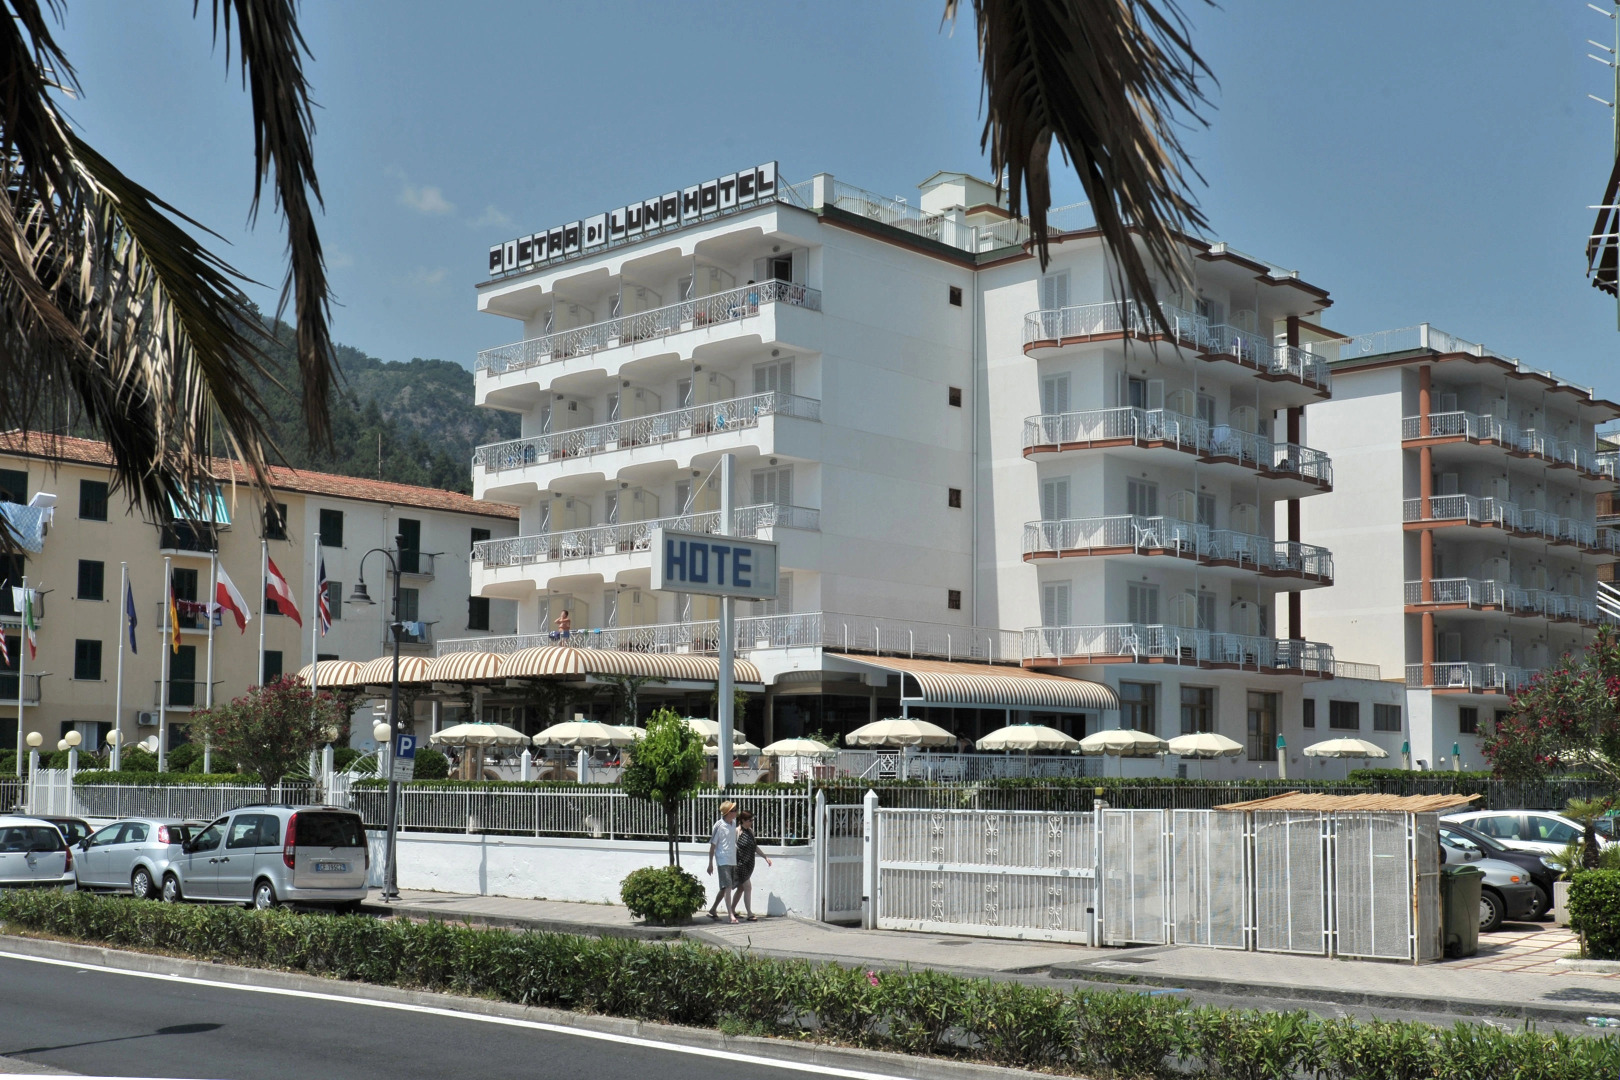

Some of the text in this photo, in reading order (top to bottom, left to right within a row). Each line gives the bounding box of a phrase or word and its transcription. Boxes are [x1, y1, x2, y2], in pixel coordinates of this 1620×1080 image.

[490, 170, 774, 269] PIETRA DI LUNA HOTEL
[400, 737, 412, 756] P
